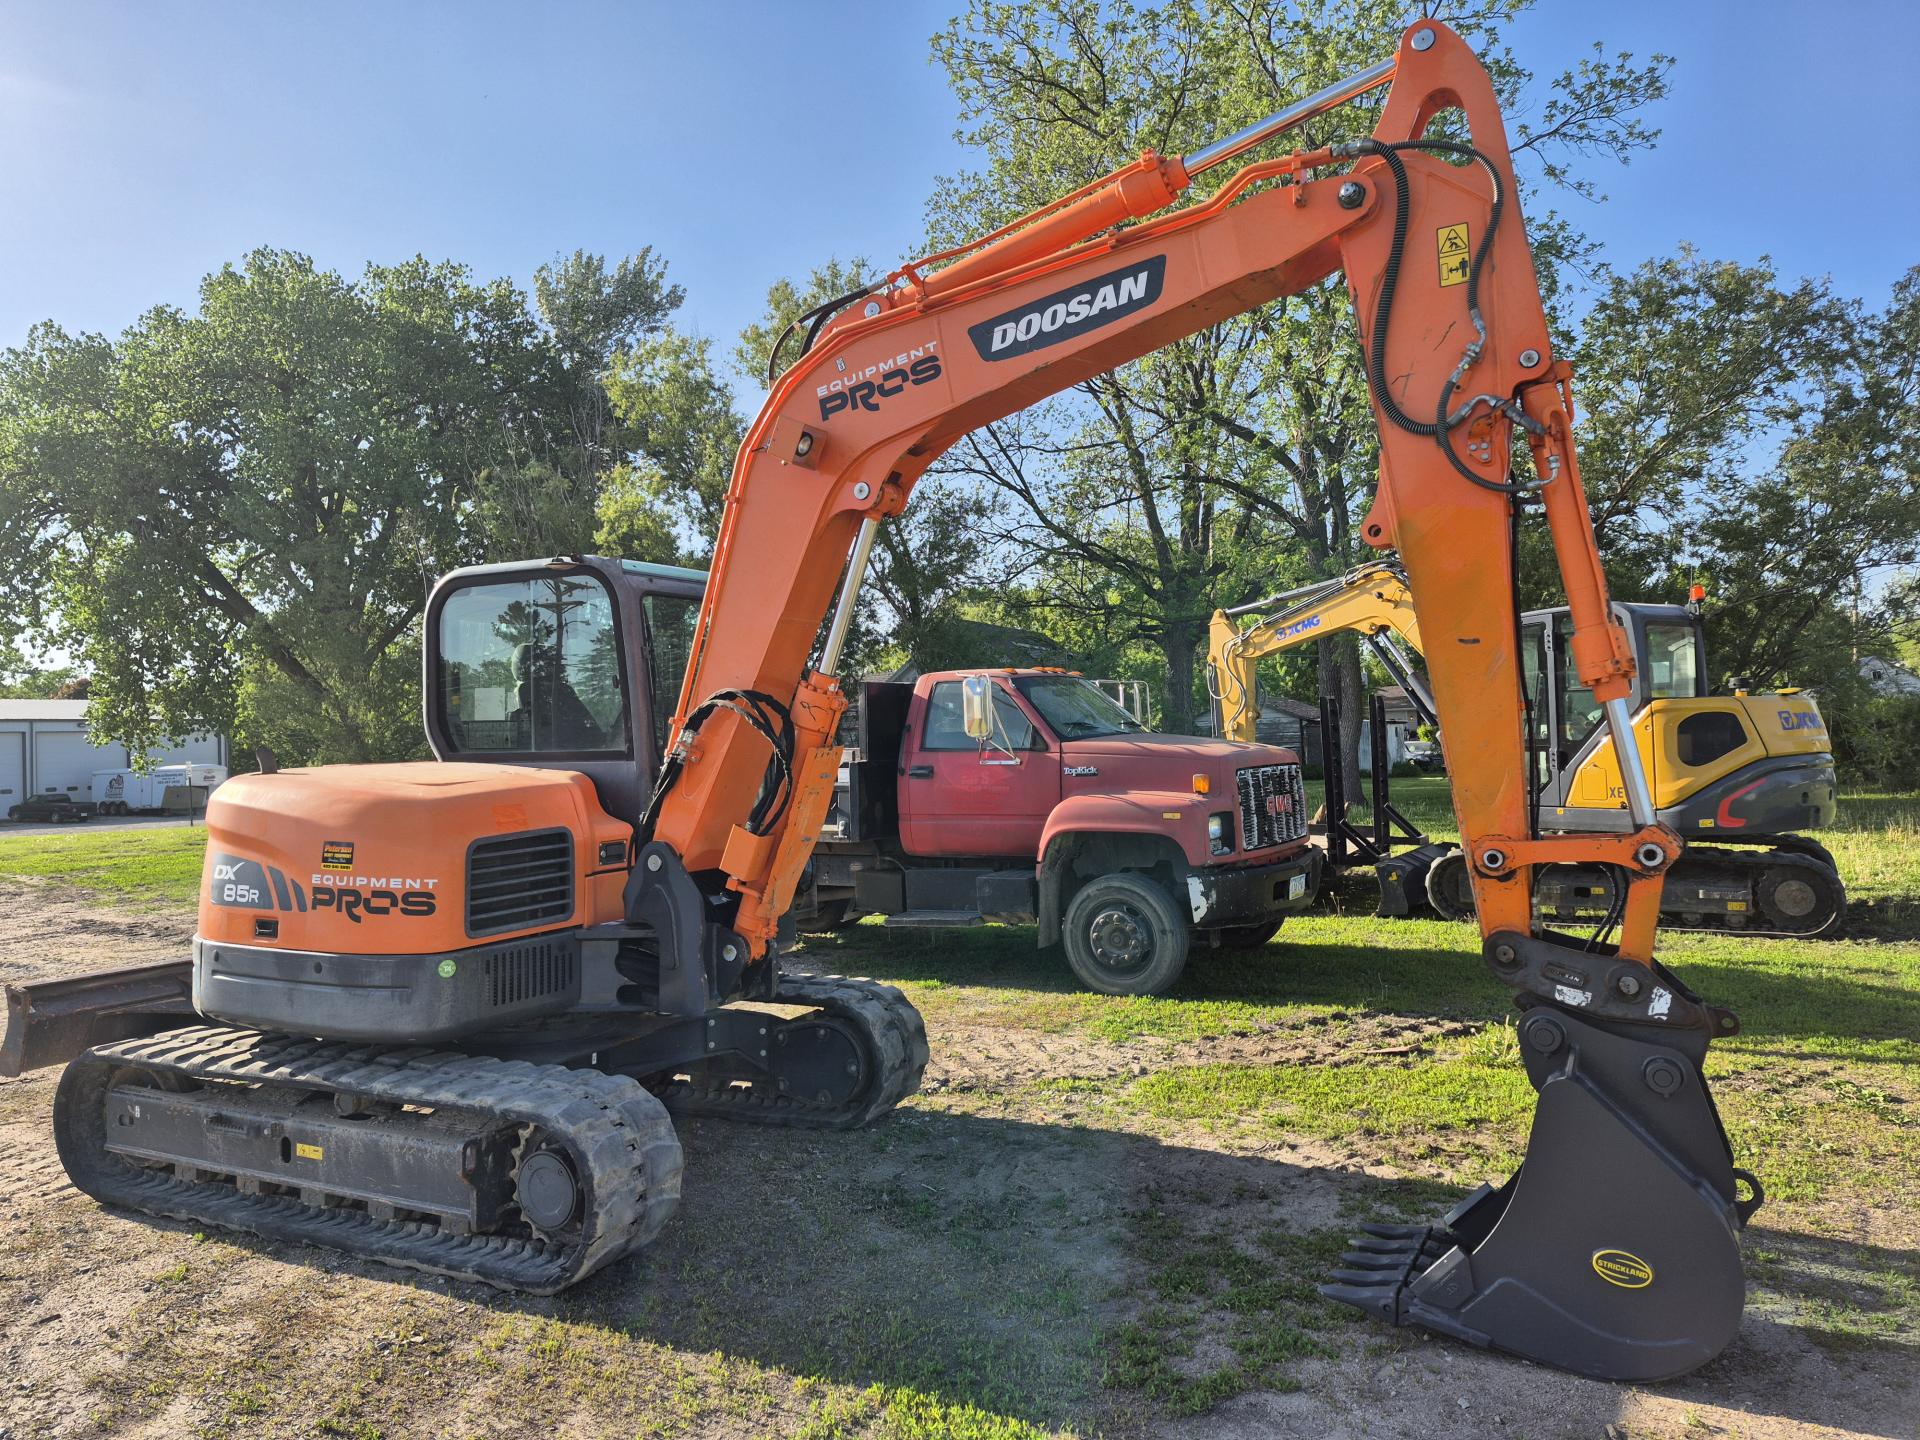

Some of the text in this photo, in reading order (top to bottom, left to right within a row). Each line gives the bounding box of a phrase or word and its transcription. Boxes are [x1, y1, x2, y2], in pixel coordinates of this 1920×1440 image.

[991, 271, 1149, 352] DOOSAN
[816, 341, 937, 397] EQUIPMENT
[819, 355, 942, 422] PROS
[1287, 615, 1320, 635] XCMG
[1063, 766, 1098, 777] TopKick
[214, 862, 246, 880] DX
[311, 874, 438, 889] EQUIPMENT
[223, 884, 260, 903] 85R
[311, 887, 437, 924] PROS
[1597, 1260, 1649, 1279] STRICKLAND
